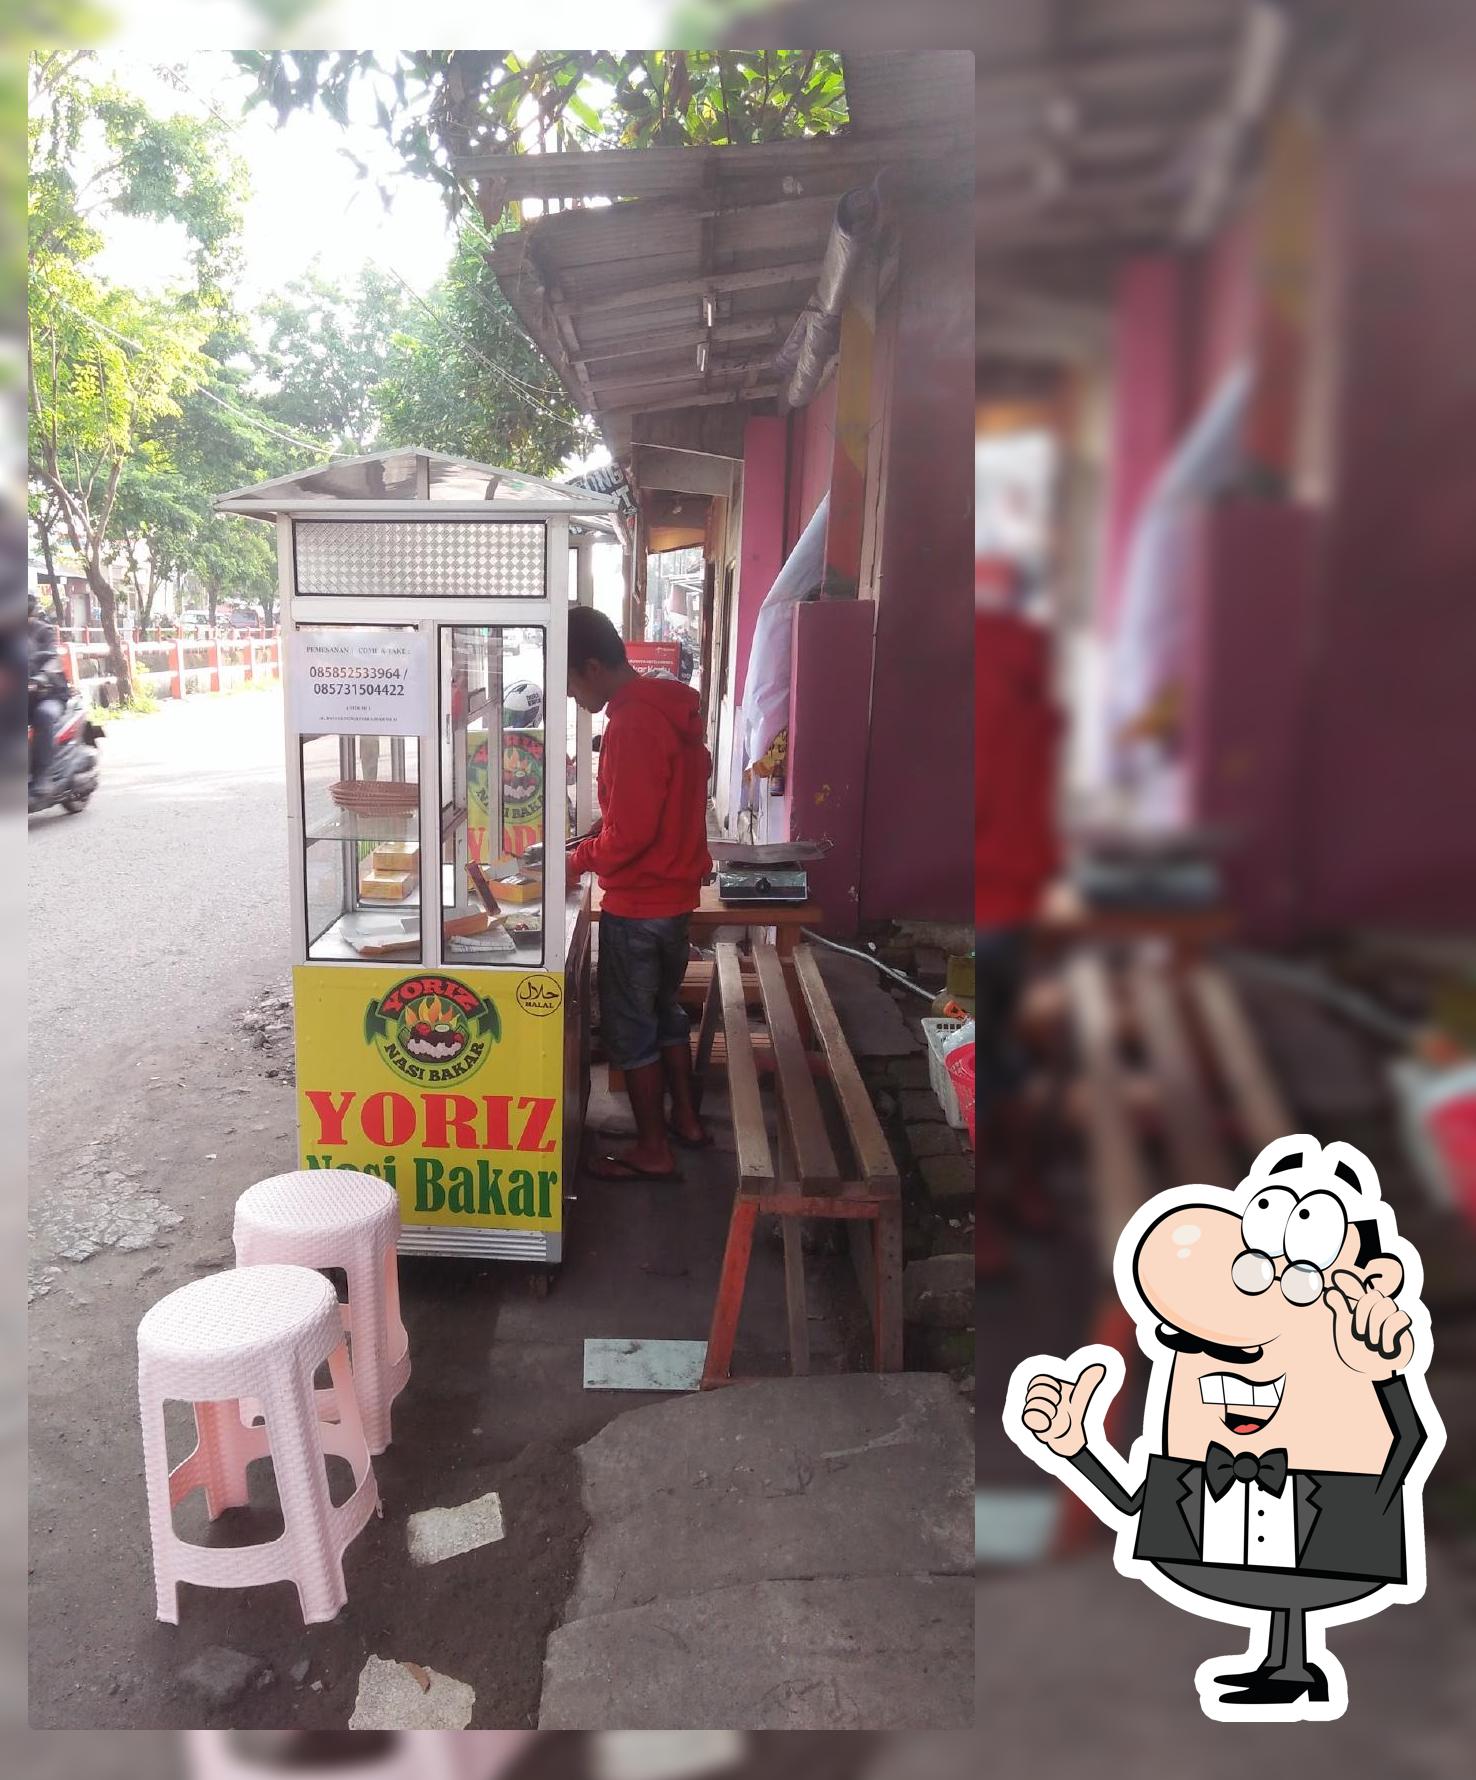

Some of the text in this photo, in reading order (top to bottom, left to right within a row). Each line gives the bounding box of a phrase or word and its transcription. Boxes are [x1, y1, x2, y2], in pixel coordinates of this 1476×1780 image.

[309, 666, 400, 680] 085852533964
[313, 683, 405, 696] 085731504422
[382, 978, 480, 1013] YORIZ
[525, 1001, 554, 1009] HALAL
[384, 1041, 485, 1081] NASI BAKAR
[305, 1090, 557, 1153] YORIZ
[413, 1157, 558, 1218] Bakar
